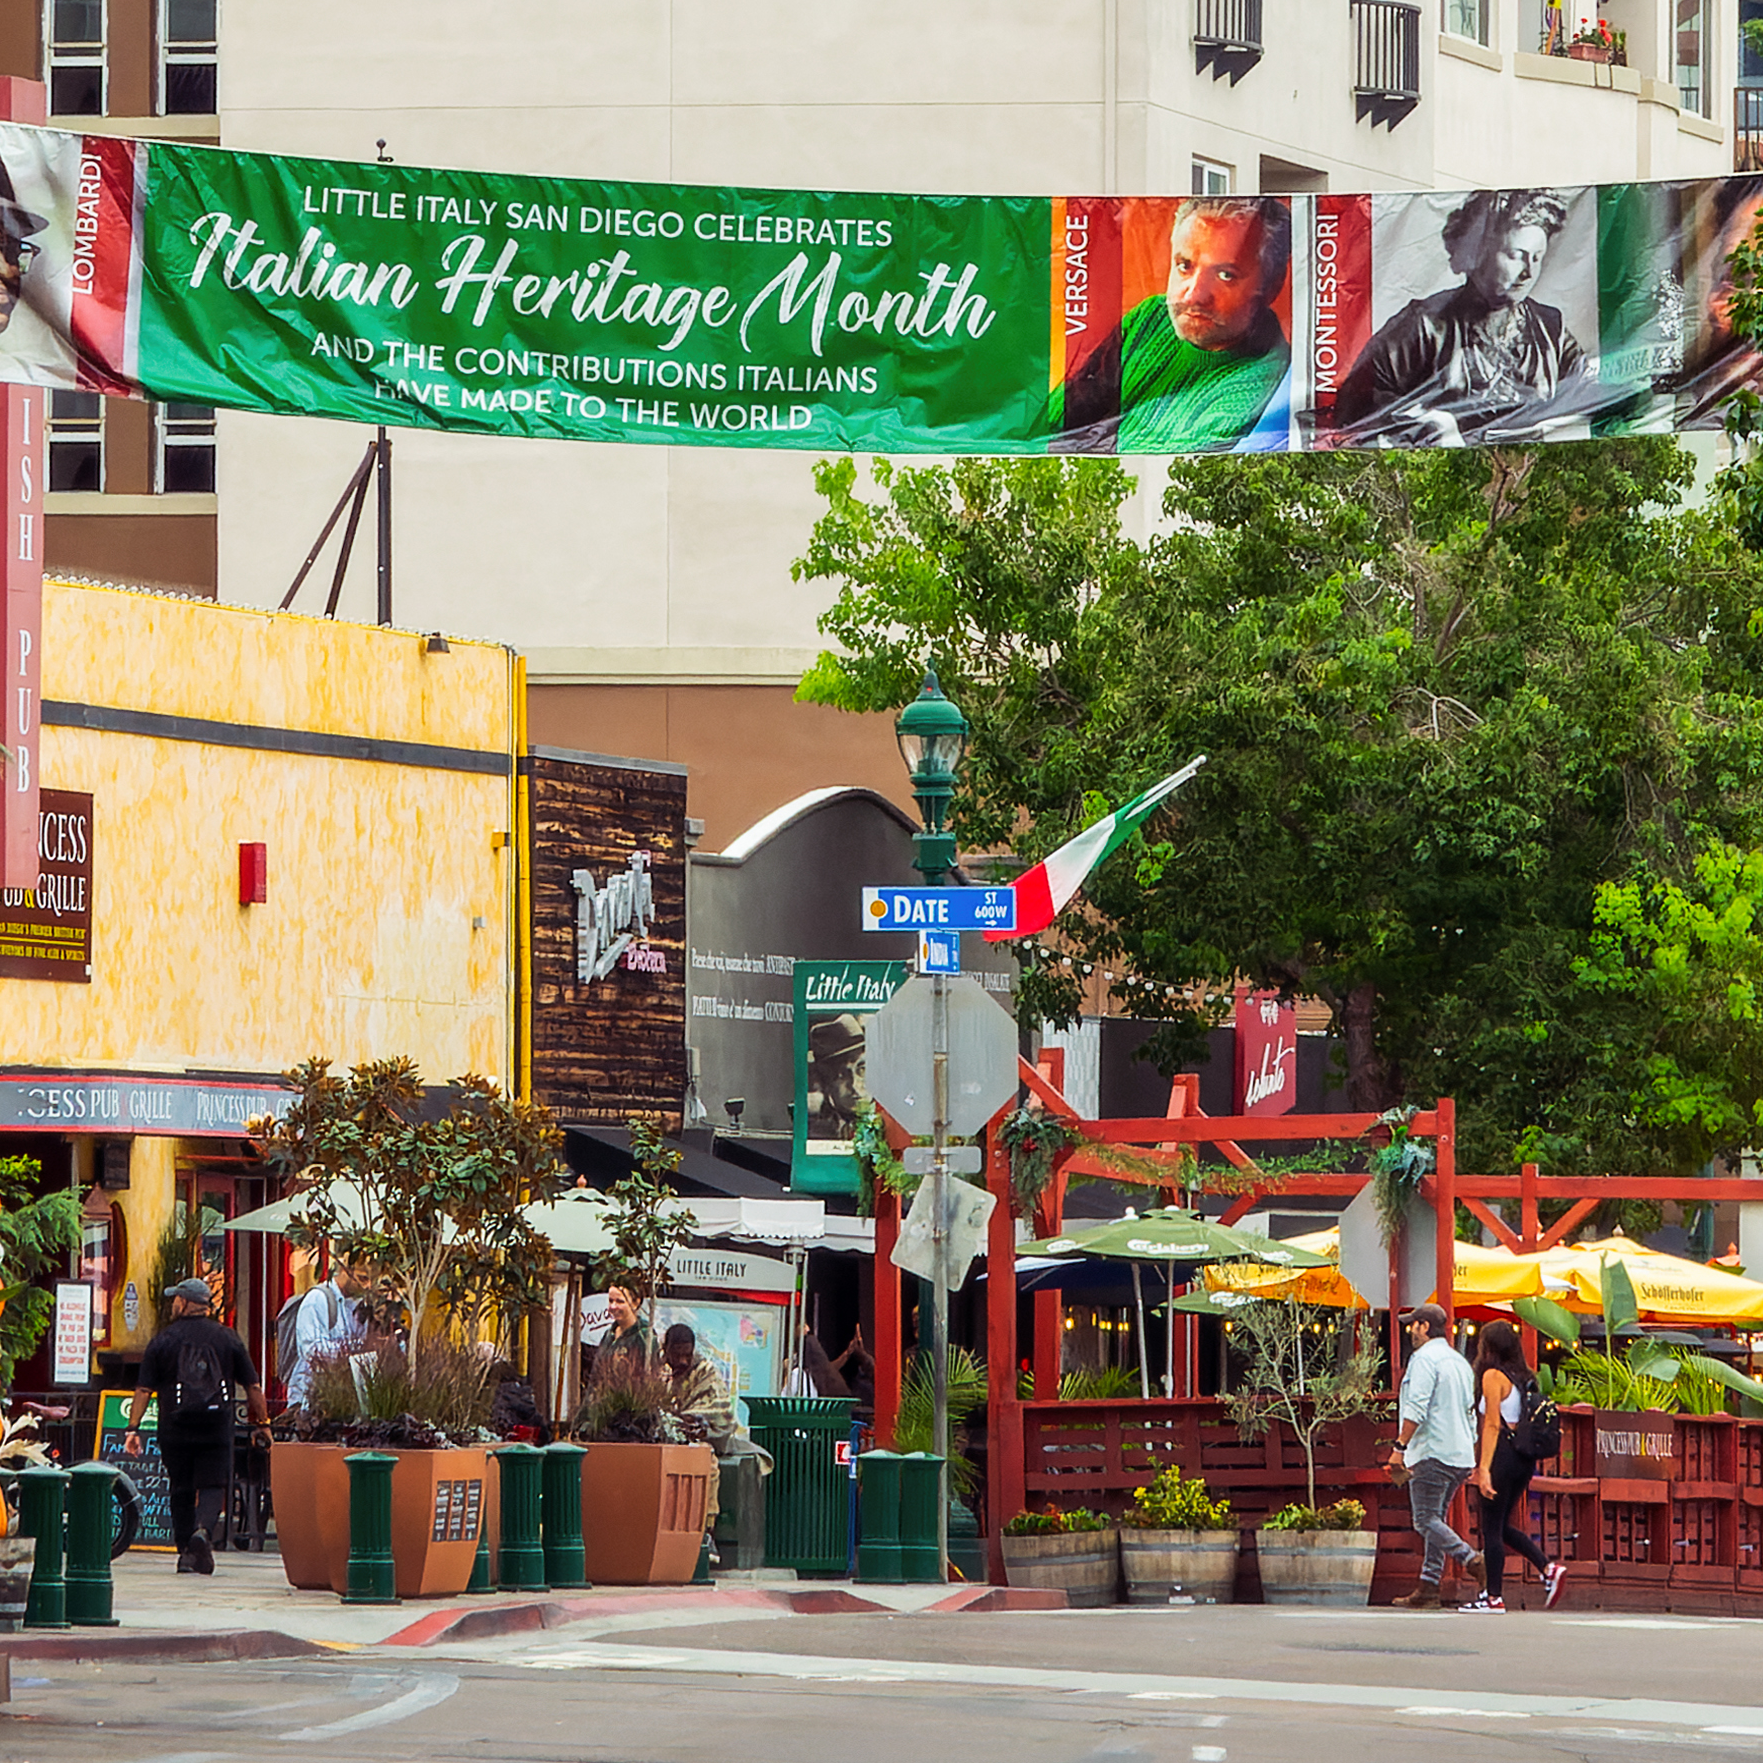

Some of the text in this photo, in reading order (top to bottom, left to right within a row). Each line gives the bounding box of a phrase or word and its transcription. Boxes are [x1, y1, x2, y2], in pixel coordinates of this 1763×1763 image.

[71, 152, 102, 296] LOMBARDI
[303, 185, 894, 249] LITTLE ITALY SAN DIEGO CELEBRATES
[189, 211, 998, 358] Italian Heritage Month
[1063, 213, 1091, 337] VERSACE
[1313, 212, 1340, 396] MONTESSORI
[310, 331, 879, 397] AND THE CONTRIBUTIONS ITALIANS
[373, 377, 814, 433] HAVE MADE TO THE WORLD
[16, 628, 34, 794] PUB
[37, 872, 87, 917] GRILLE
[893, 894, 950, 924] DATE
[974, 904, 1008, 919] 600W
[984, 891, 998, 905] ST
[805, 960, 897, 1002] Little Italy
[89, 1089, 120, 1119] PUB
[129, 1090, 174, 1125] GRILLE
[676, 1259, 748, 1279] LITTLE ITALY
